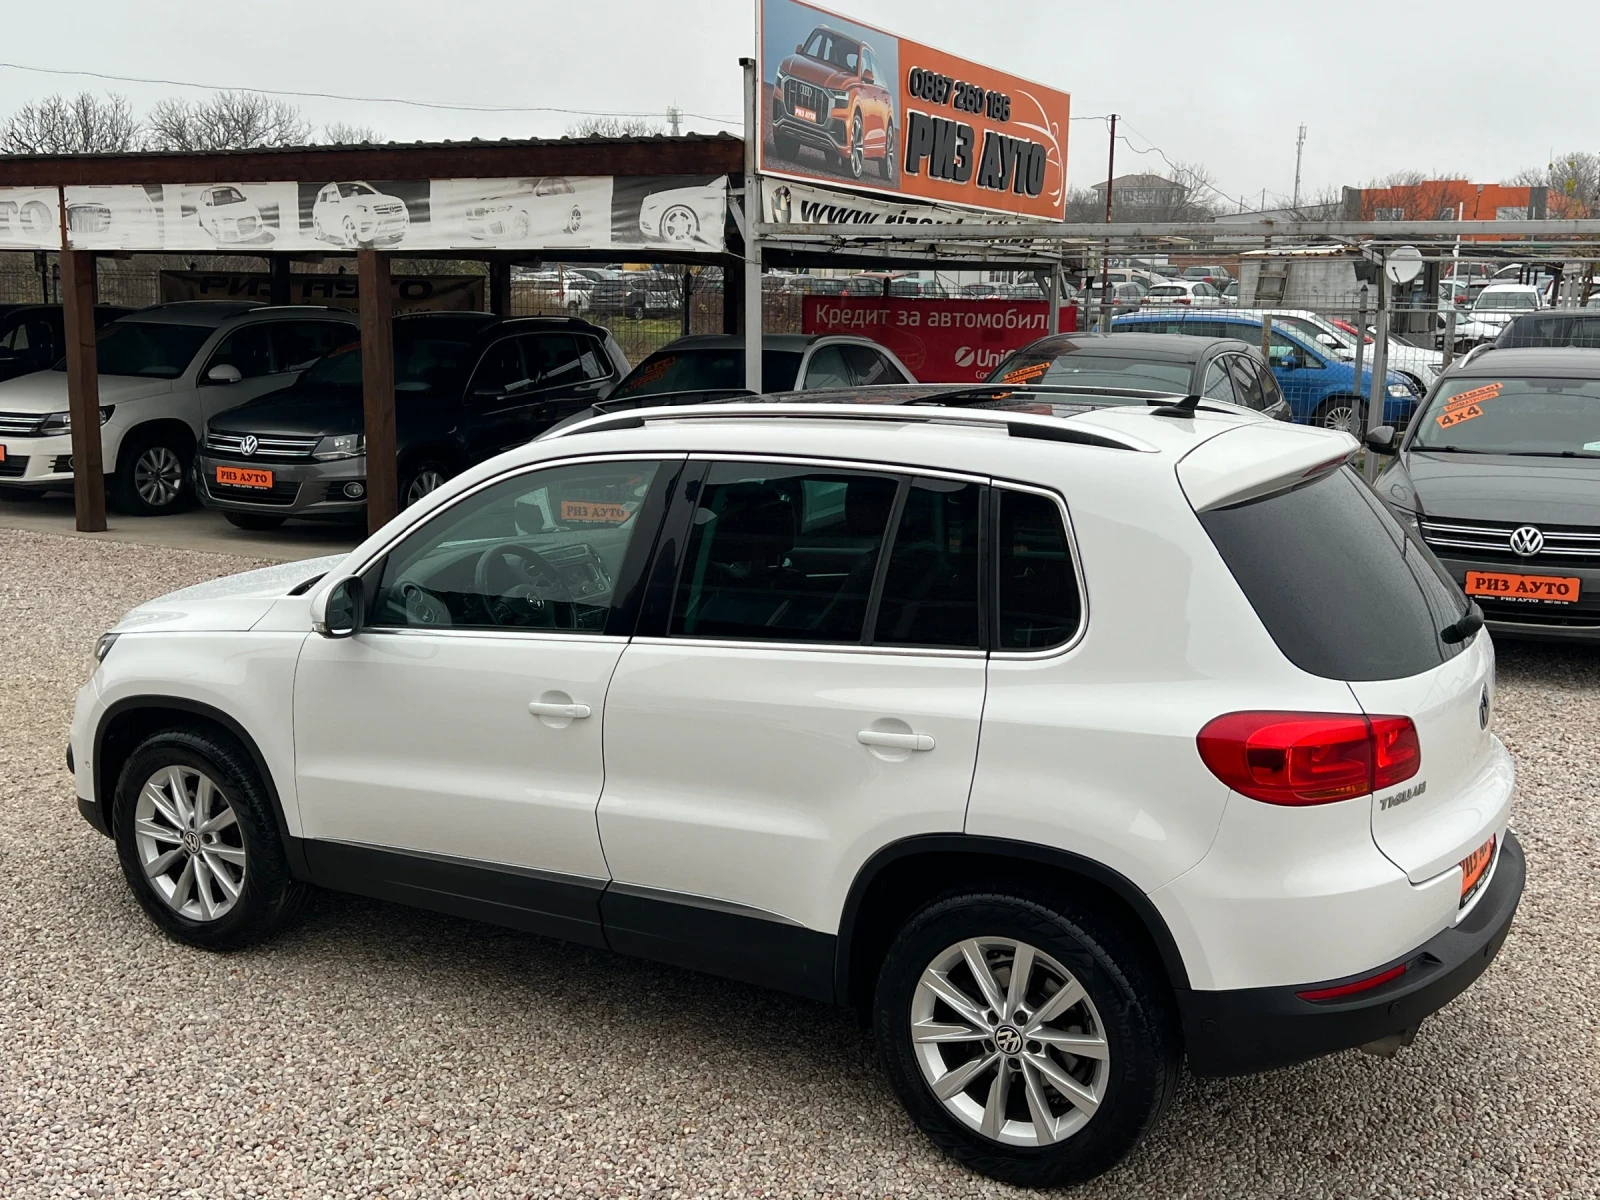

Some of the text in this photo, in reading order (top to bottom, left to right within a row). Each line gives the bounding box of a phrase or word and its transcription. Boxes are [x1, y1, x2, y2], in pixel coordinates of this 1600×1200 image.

[908, 67, 1011, 123] 0887 260 186
[904, 108, 1047, 198] РИЗ АУТО
[816, 304, 1050, 330] Кредит за автомобил
[1452, 384, 1500, 401] Diesel
[221, 470, 268, 483] РИЗ АУТО
[566, 505, 625, 517] РИЗ АУТО
[1475, 577, 1570, 595] РИЗ АУТО
[1380, 781, 1427, 811] TIGUAN
